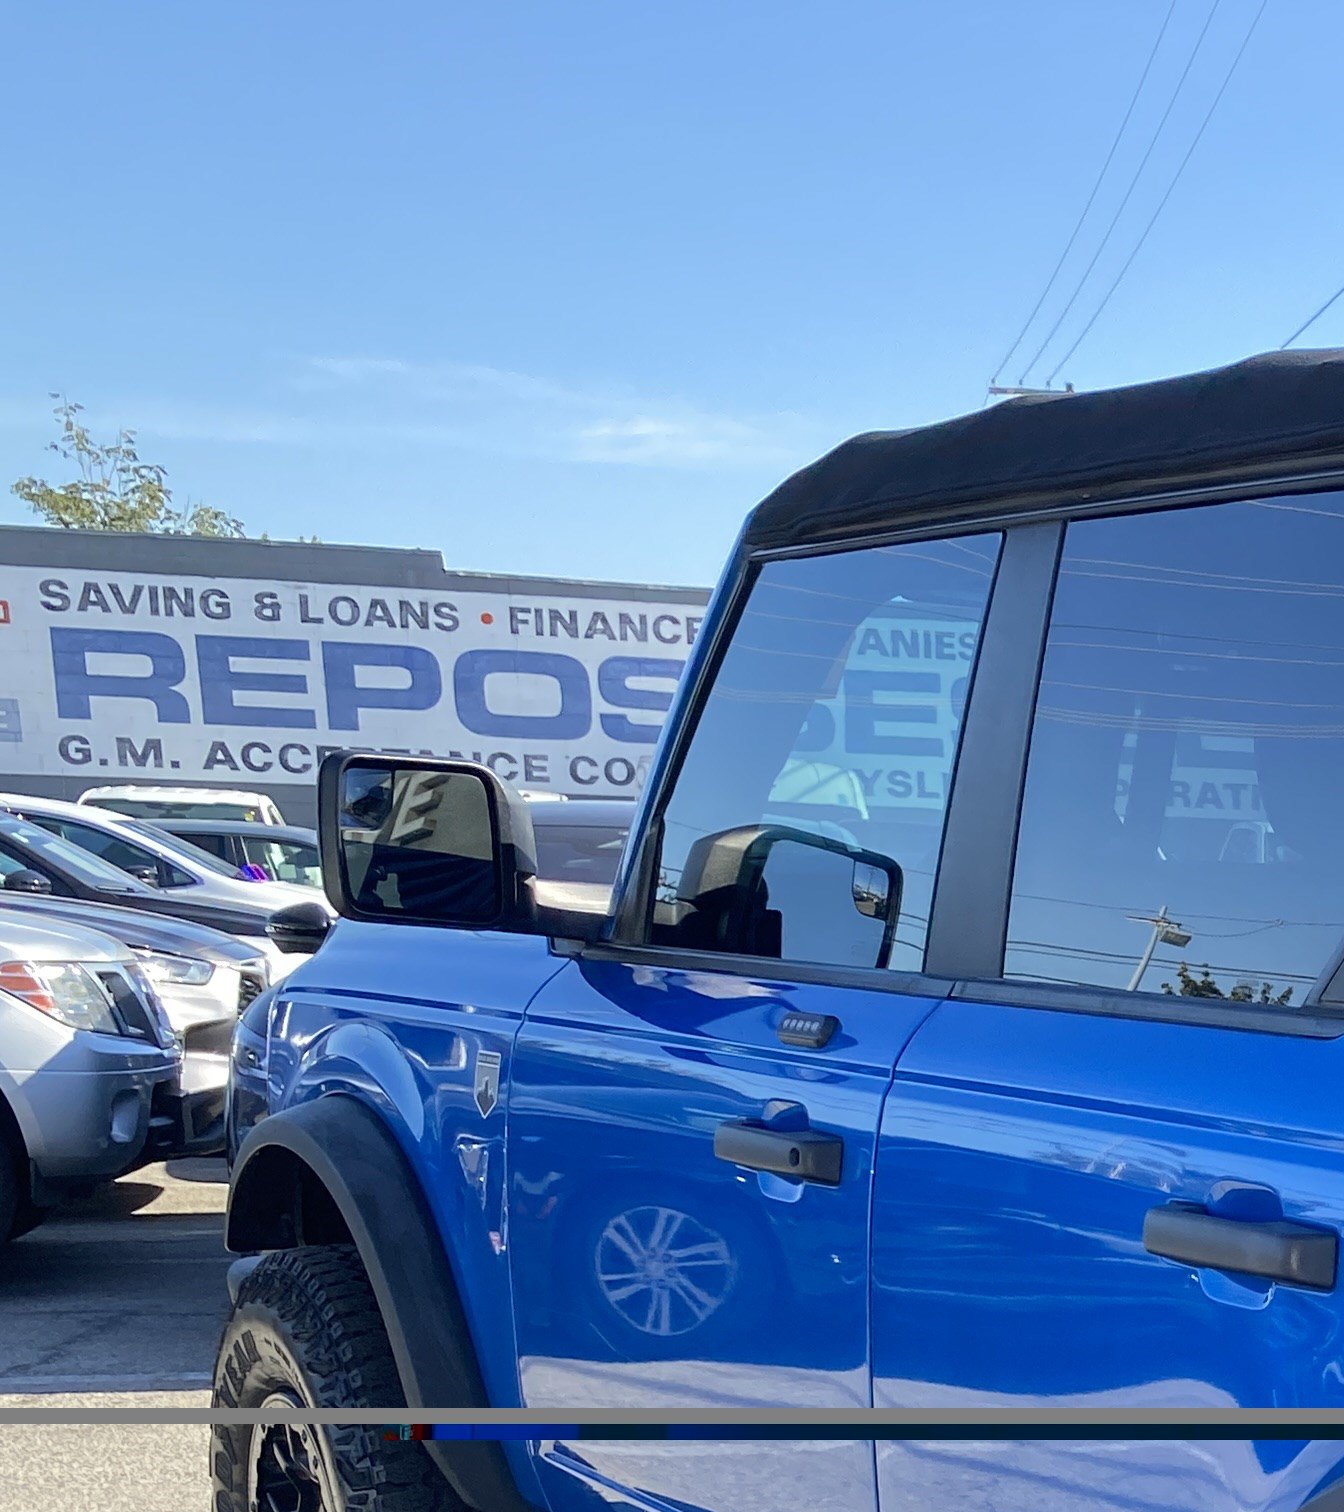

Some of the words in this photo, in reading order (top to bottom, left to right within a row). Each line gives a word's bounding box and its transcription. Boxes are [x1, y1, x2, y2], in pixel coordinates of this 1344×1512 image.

[39, 578, 231, 620] SAVING
[254, 591, 281, 621] &
[299, 593, 460, 632] LOANS
[58, 735, 181, 770] G.M.
[851, 768, 948, 799] YSL
